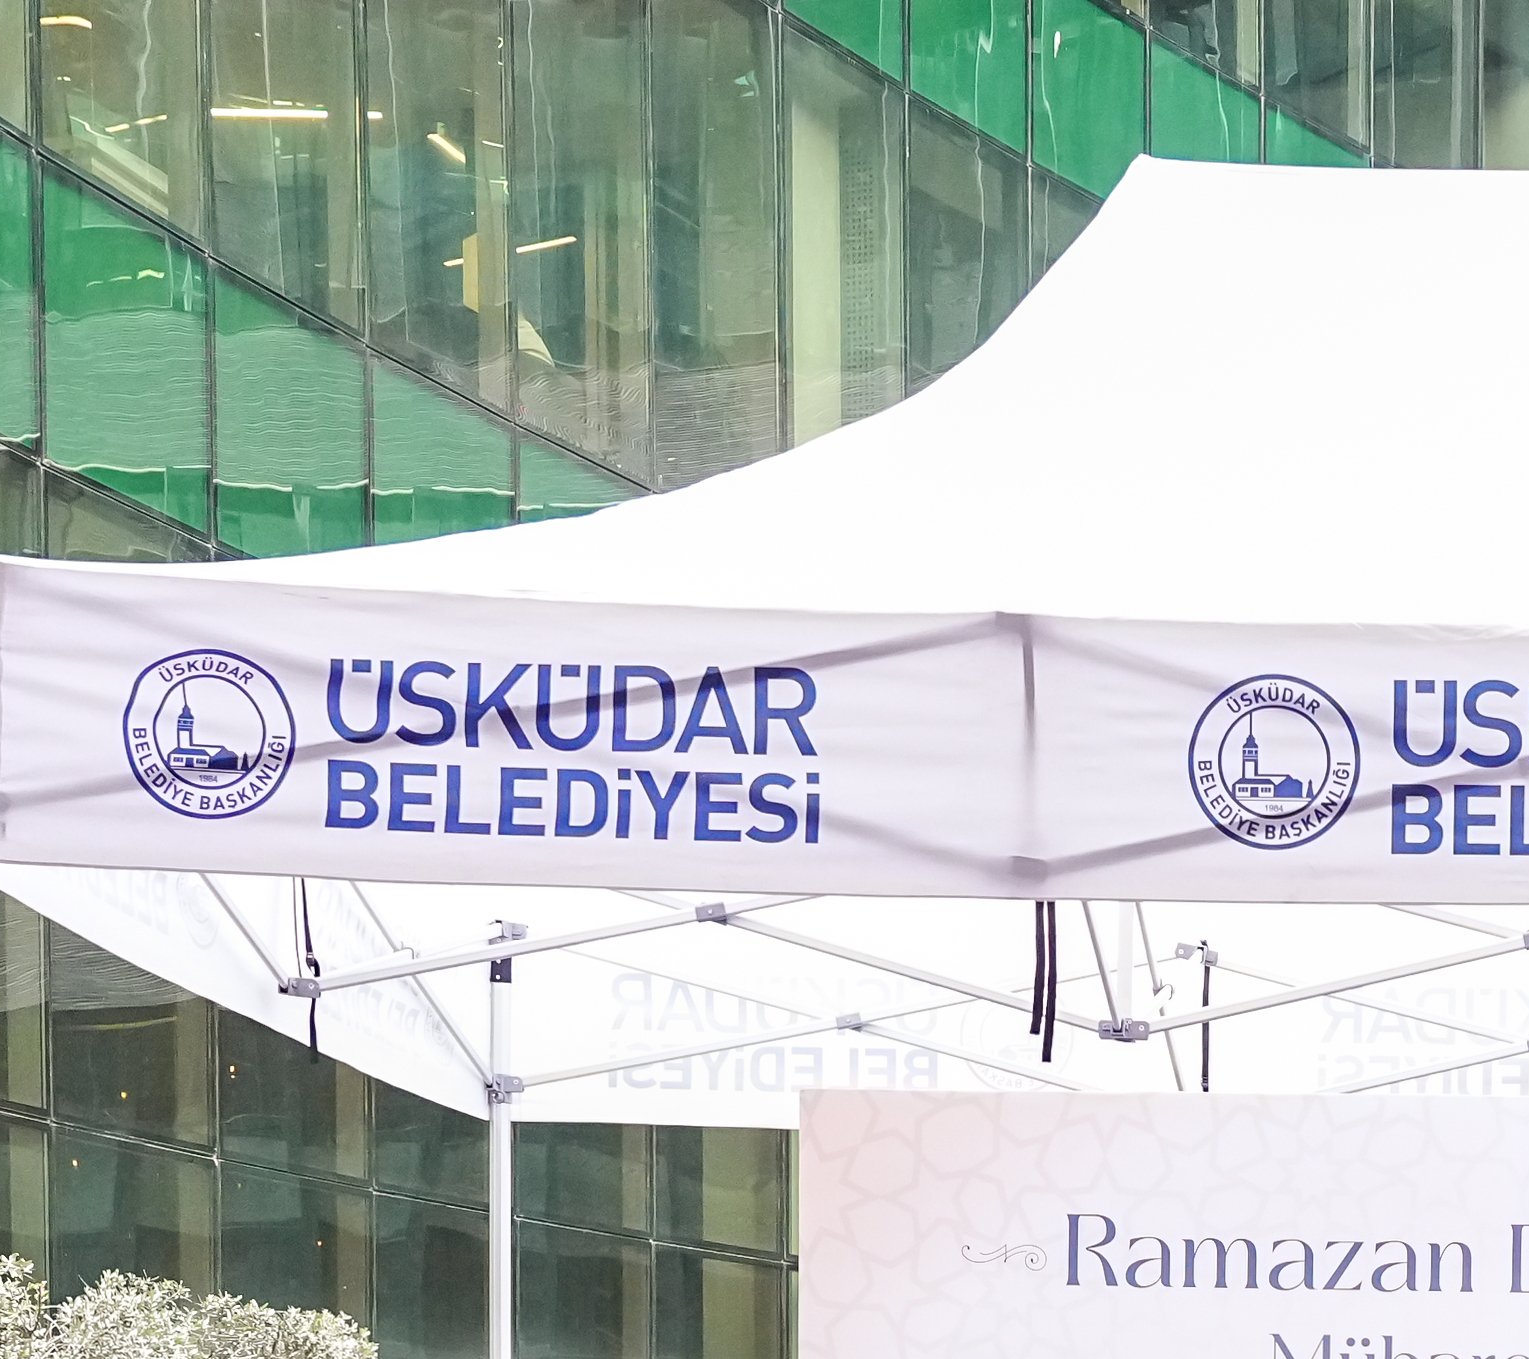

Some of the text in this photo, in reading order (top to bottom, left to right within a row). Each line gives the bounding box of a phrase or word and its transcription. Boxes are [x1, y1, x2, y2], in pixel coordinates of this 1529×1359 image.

[158, 657, 254, 685] ÜSKÜDAR
[326, 660, 817, 756] ÜSKÜDAR
[1226, 682, 1321, 715] ÜSKÜDAR
[133, 727, 287, 810] BELEDİYE BAŞKANLIĞI
[1197, 760, 1351, 840] BELEDİYE BAŞKANLIĞI
[1064, 1212, 1474, 1294] Ramazan
